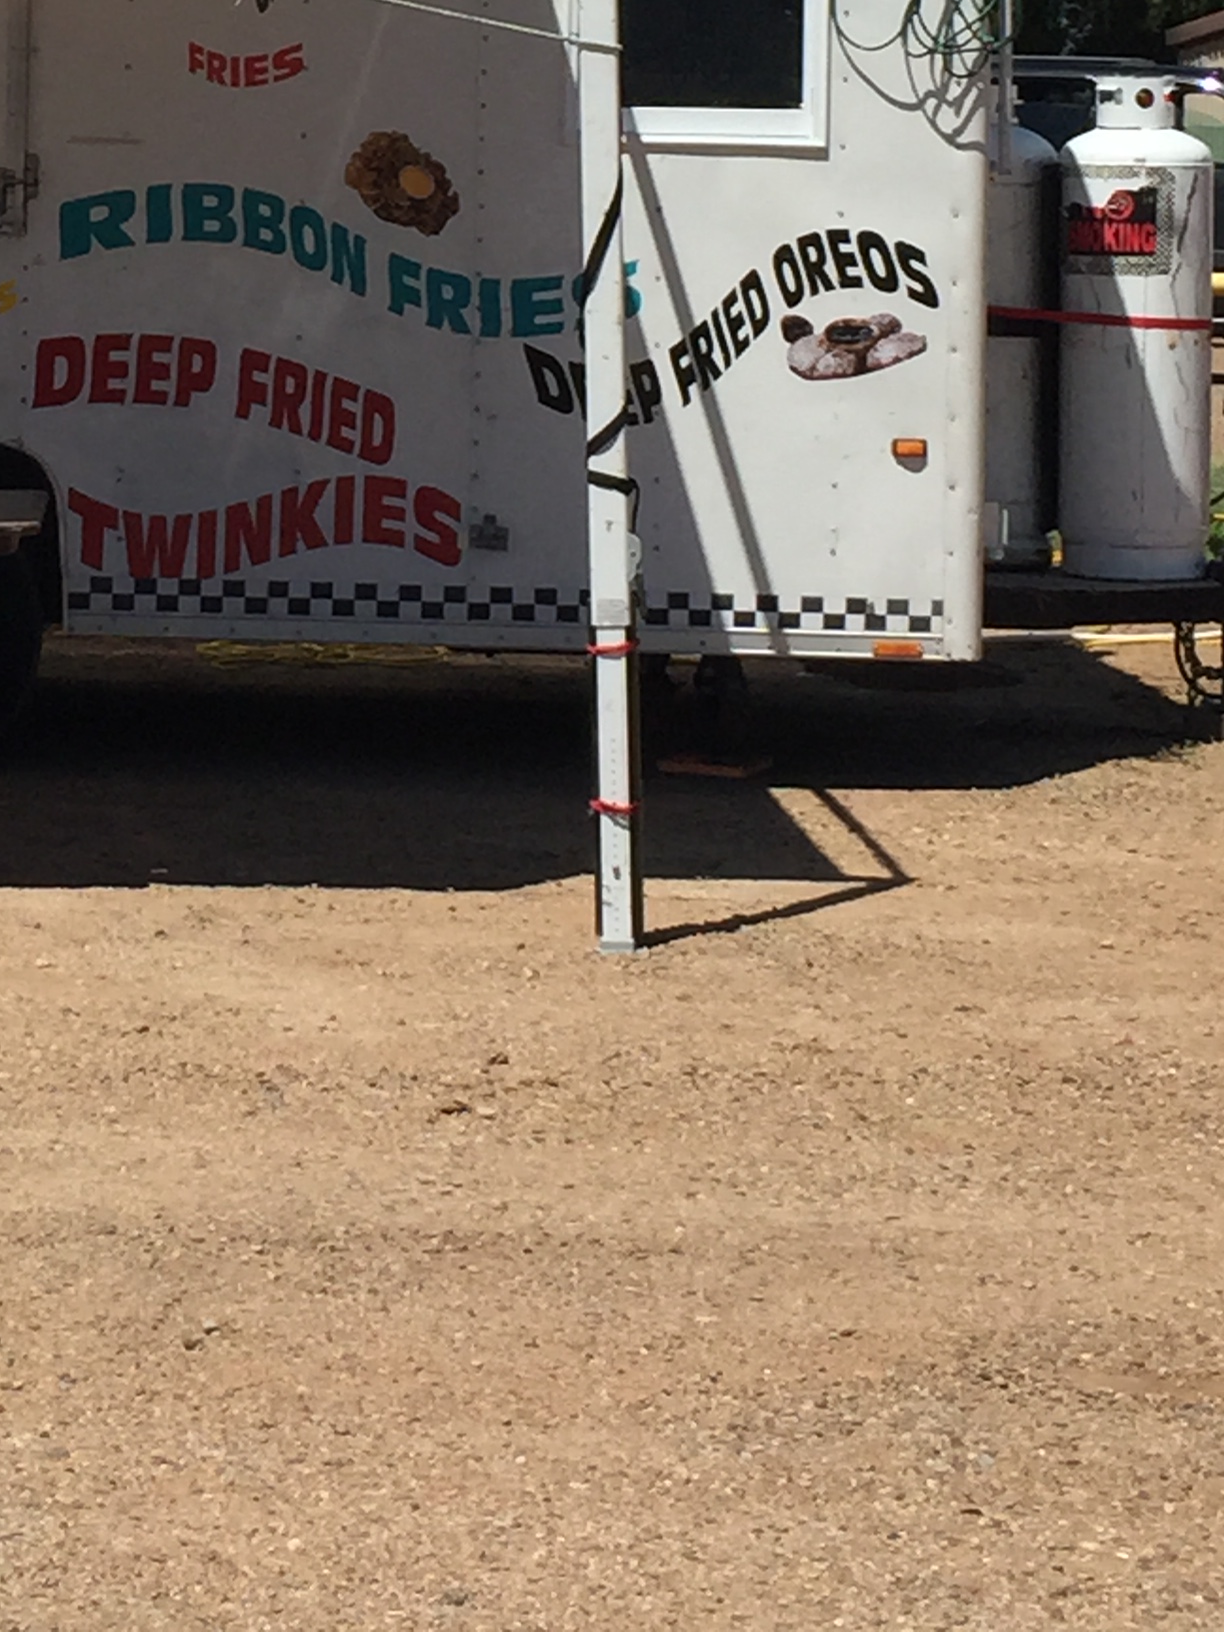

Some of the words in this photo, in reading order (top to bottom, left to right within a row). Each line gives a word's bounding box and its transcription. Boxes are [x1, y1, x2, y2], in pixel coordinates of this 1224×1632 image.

[188, 42, 307, 88] FRIES
[58, 183, 368, 297] RIBBON
[1068, 220, 1157, 253] SMOKING
[523, 342, 662, 426] DP
[668, 268, 771, 408] FRIED
[772, 228, 940, 309] OREOS
[32, 333, 217, 408] DEEP
[235, 347, 396, 465] FRIED
[68, 475, 462, 580] TWINKIES
